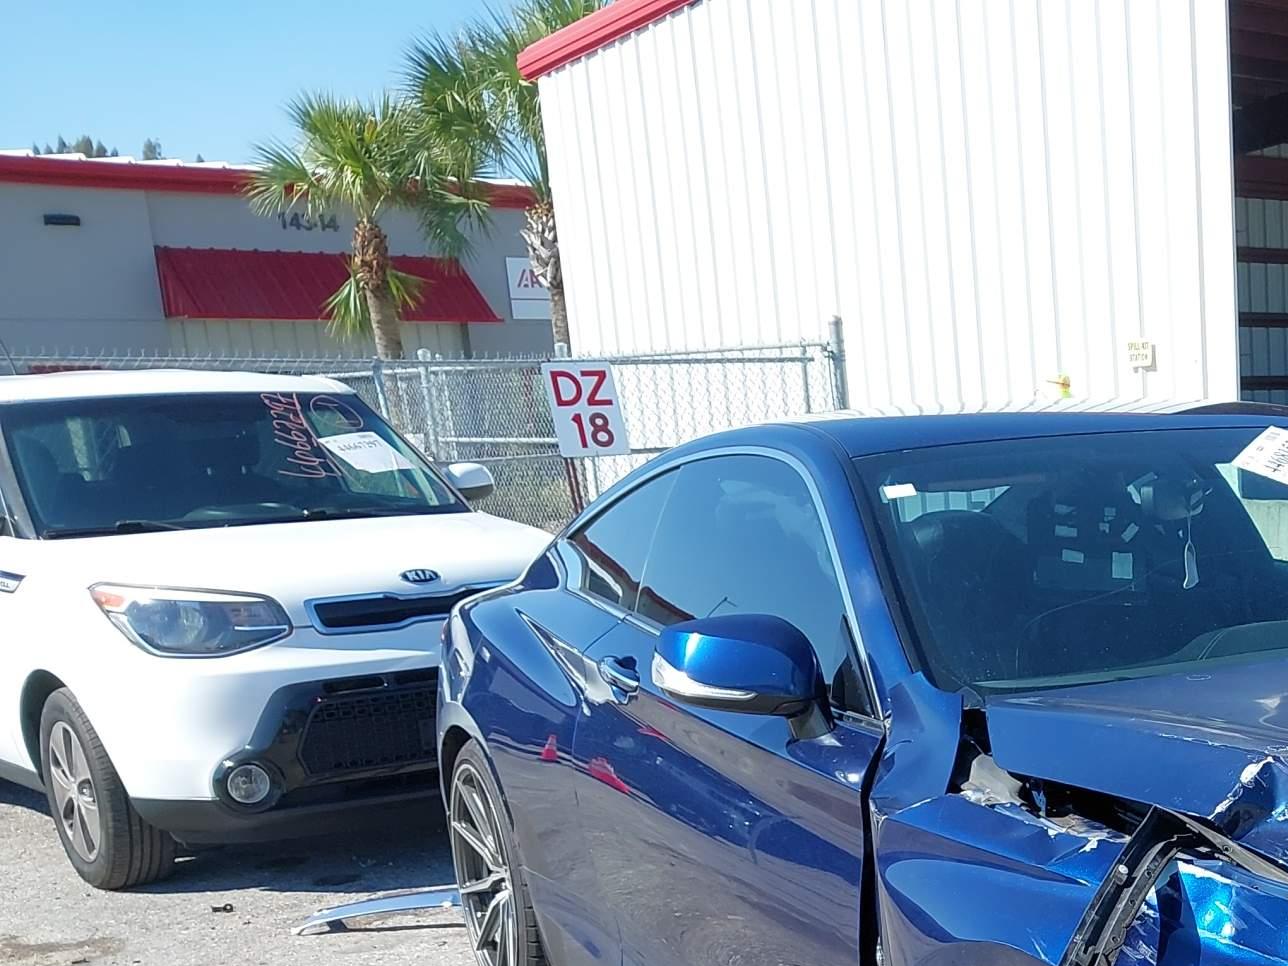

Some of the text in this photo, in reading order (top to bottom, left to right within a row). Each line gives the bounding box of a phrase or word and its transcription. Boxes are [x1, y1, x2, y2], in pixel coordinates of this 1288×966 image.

[549, 370, 613, 407] DZ
[571, 412, 615, 449] 18
[405, 570, 437, 581] KIA
